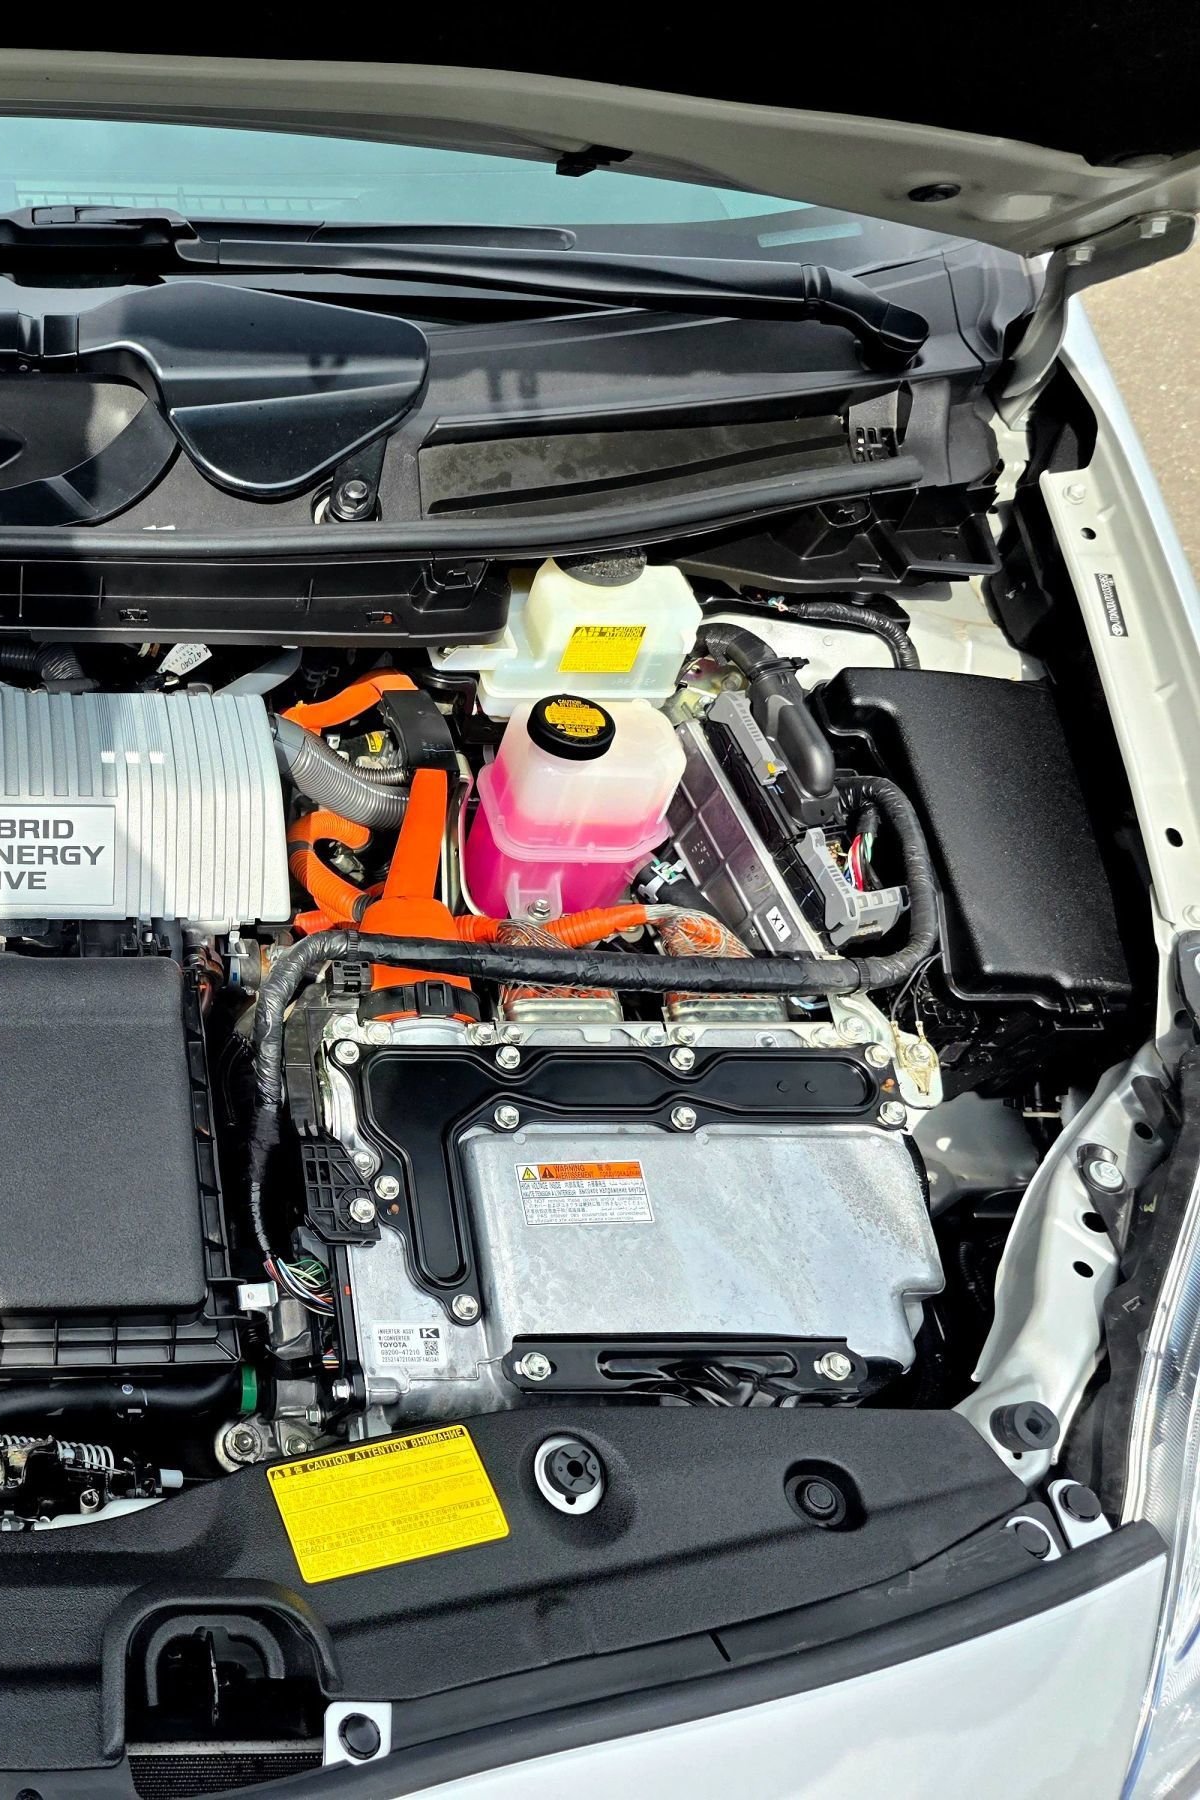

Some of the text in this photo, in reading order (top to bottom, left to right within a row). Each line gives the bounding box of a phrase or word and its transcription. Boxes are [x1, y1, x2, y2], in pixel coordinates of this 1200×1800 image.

[770, 913, 785, 932] X1
[554, 1164, 585, 1172] WARNING
[422, 1328, 437, 1338] K
[410, 1428, 464, 1447] ВНИМАНИЕ
[306, 1441, 408, 1471] CAUTION ATTENTION
